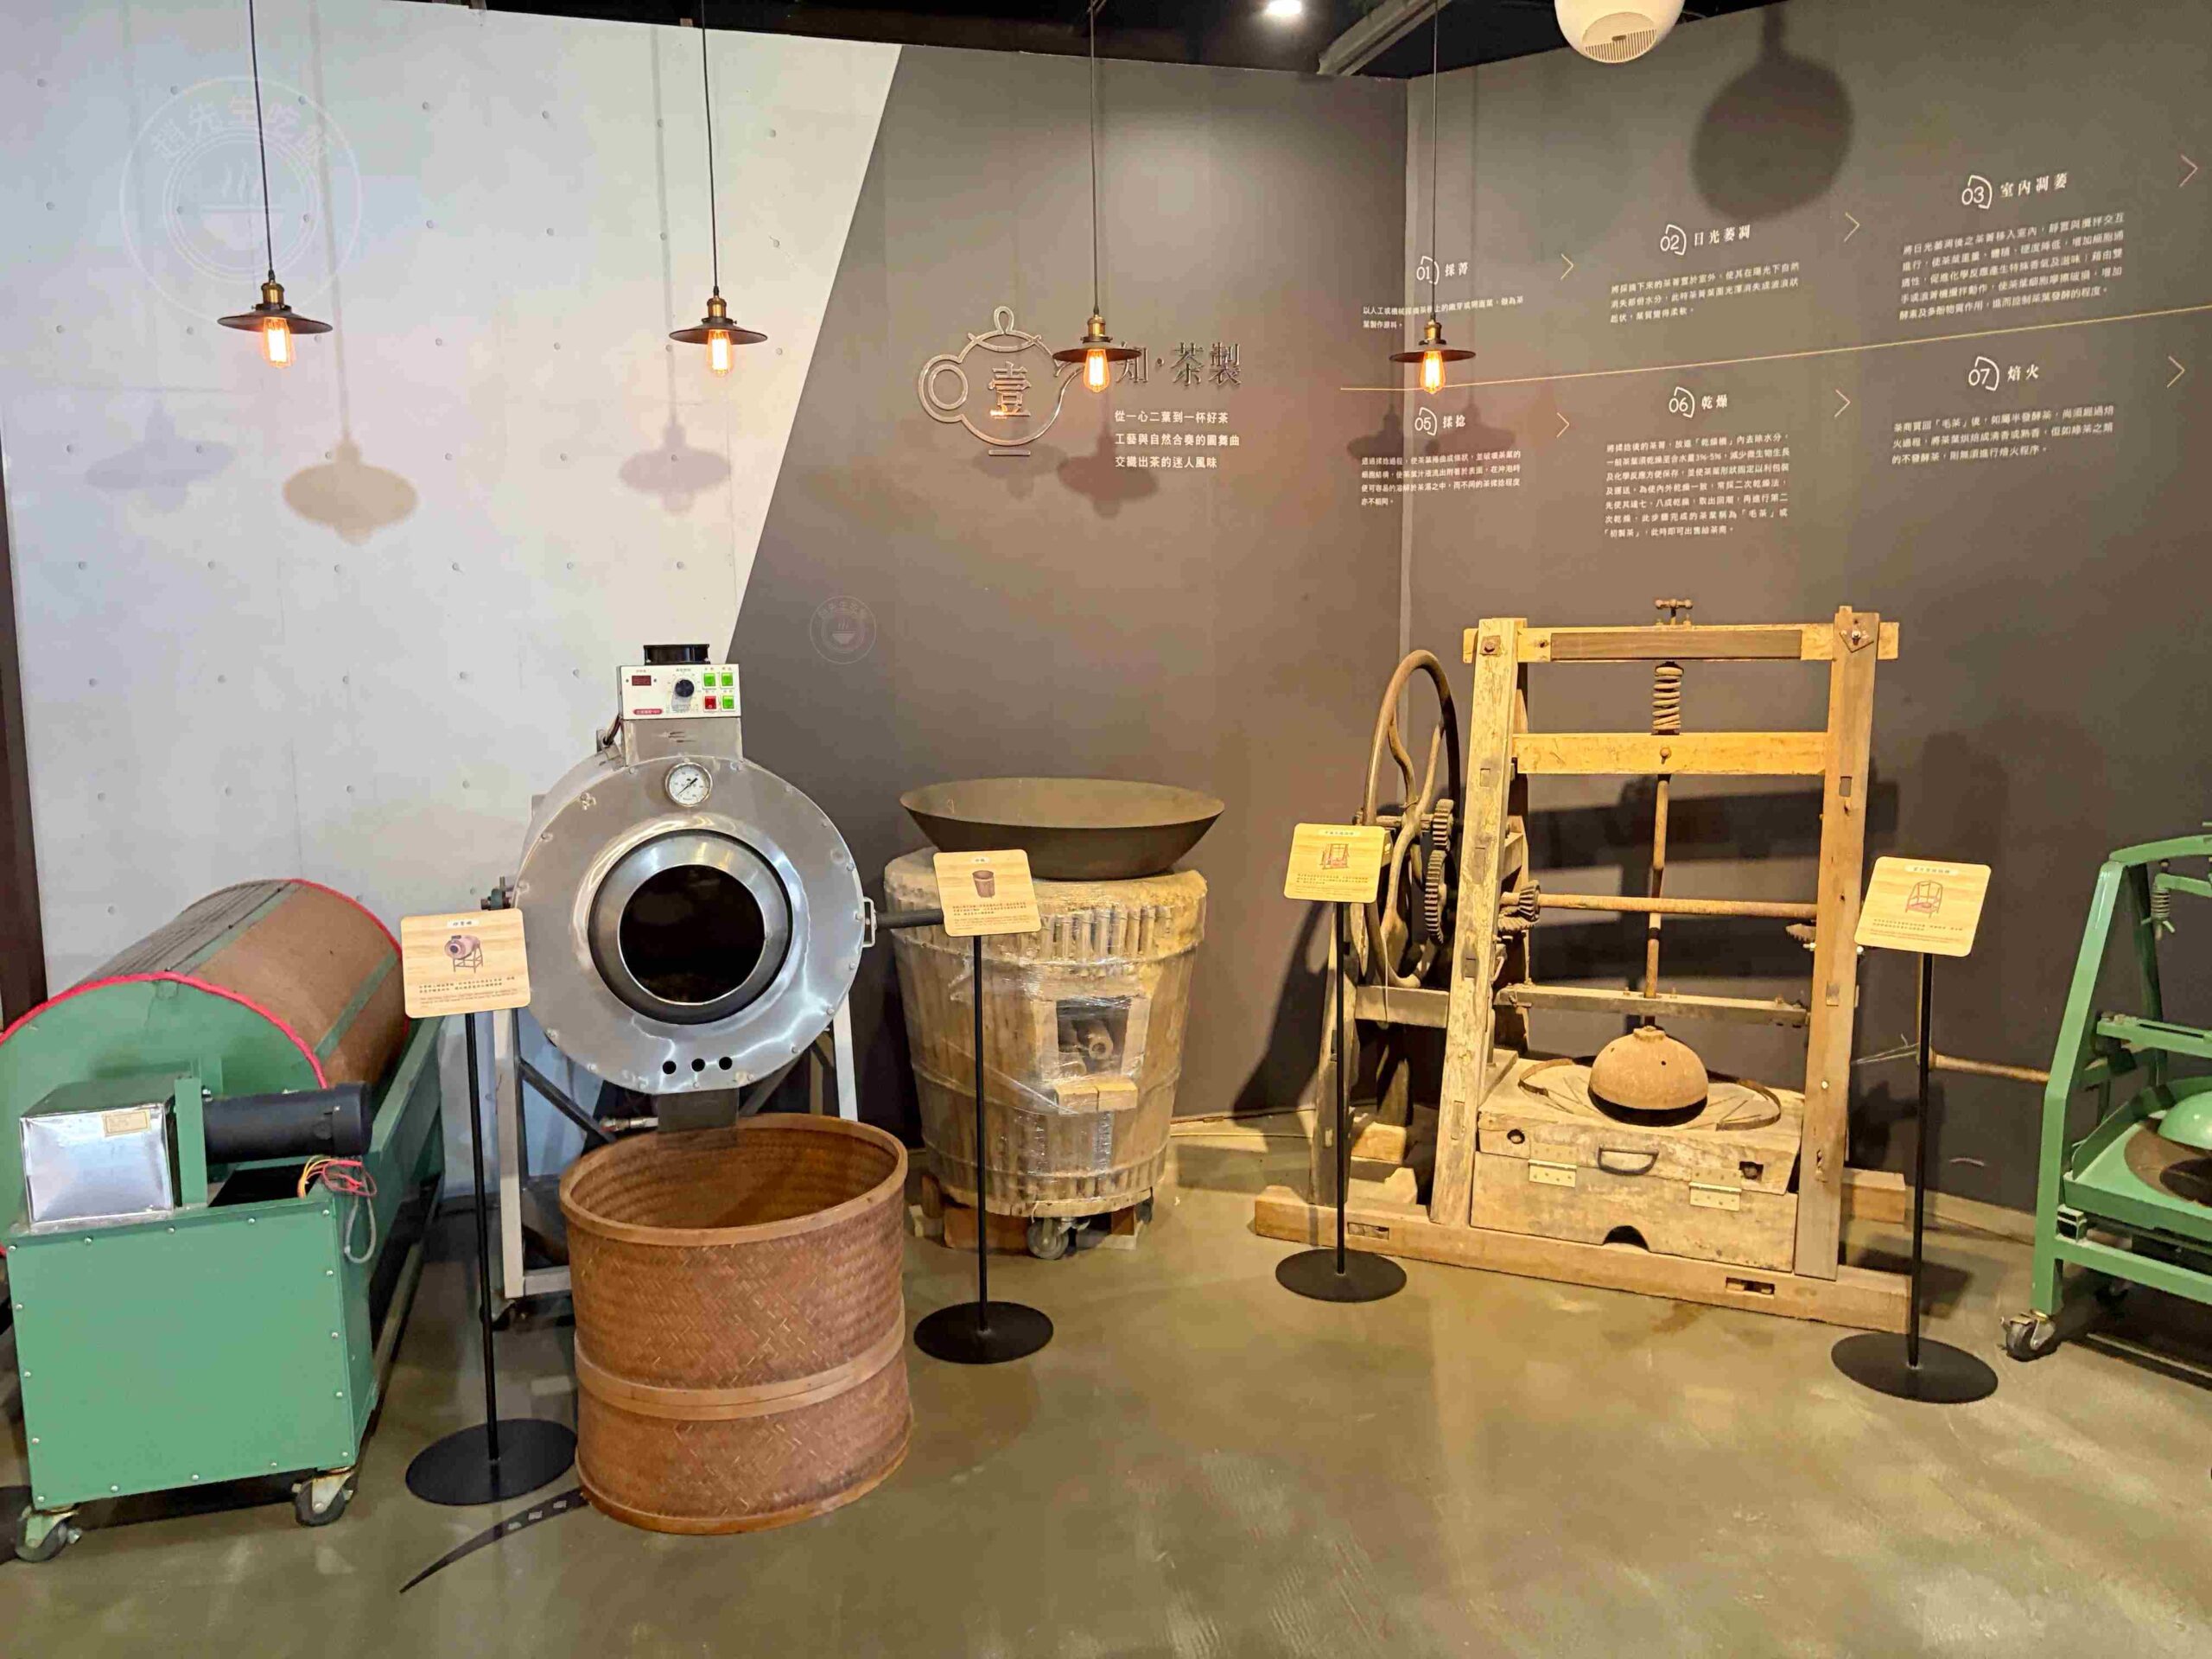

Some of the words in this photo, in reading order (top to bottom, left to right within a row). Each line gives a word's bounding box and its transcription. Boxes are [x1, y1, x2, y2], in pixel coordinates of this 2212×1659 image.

[1961, 187, 1984, 205] 03
[1660, 235, 1679, 251] 02
[1694, 225, 1750, 247] 日光萎凋
[1968, 368, 1990, 386] 07
[2007, 364, 2039, 382] 焙火
[988, 361, 1032, 418] 壹
[1669, 397, 1688, 413] 06
[1701, 394, 1728, 410] 乾燥
[1115, 410, 1228, 423] 從一心二葉到一杯好茶
[1414, 417, 1431, 431] 05
[1115, 434, 1240, 446] 工藝與自然合奏的圓舞曲
[1115, 456, 1217, 468] 交織出茶的迷人風味
